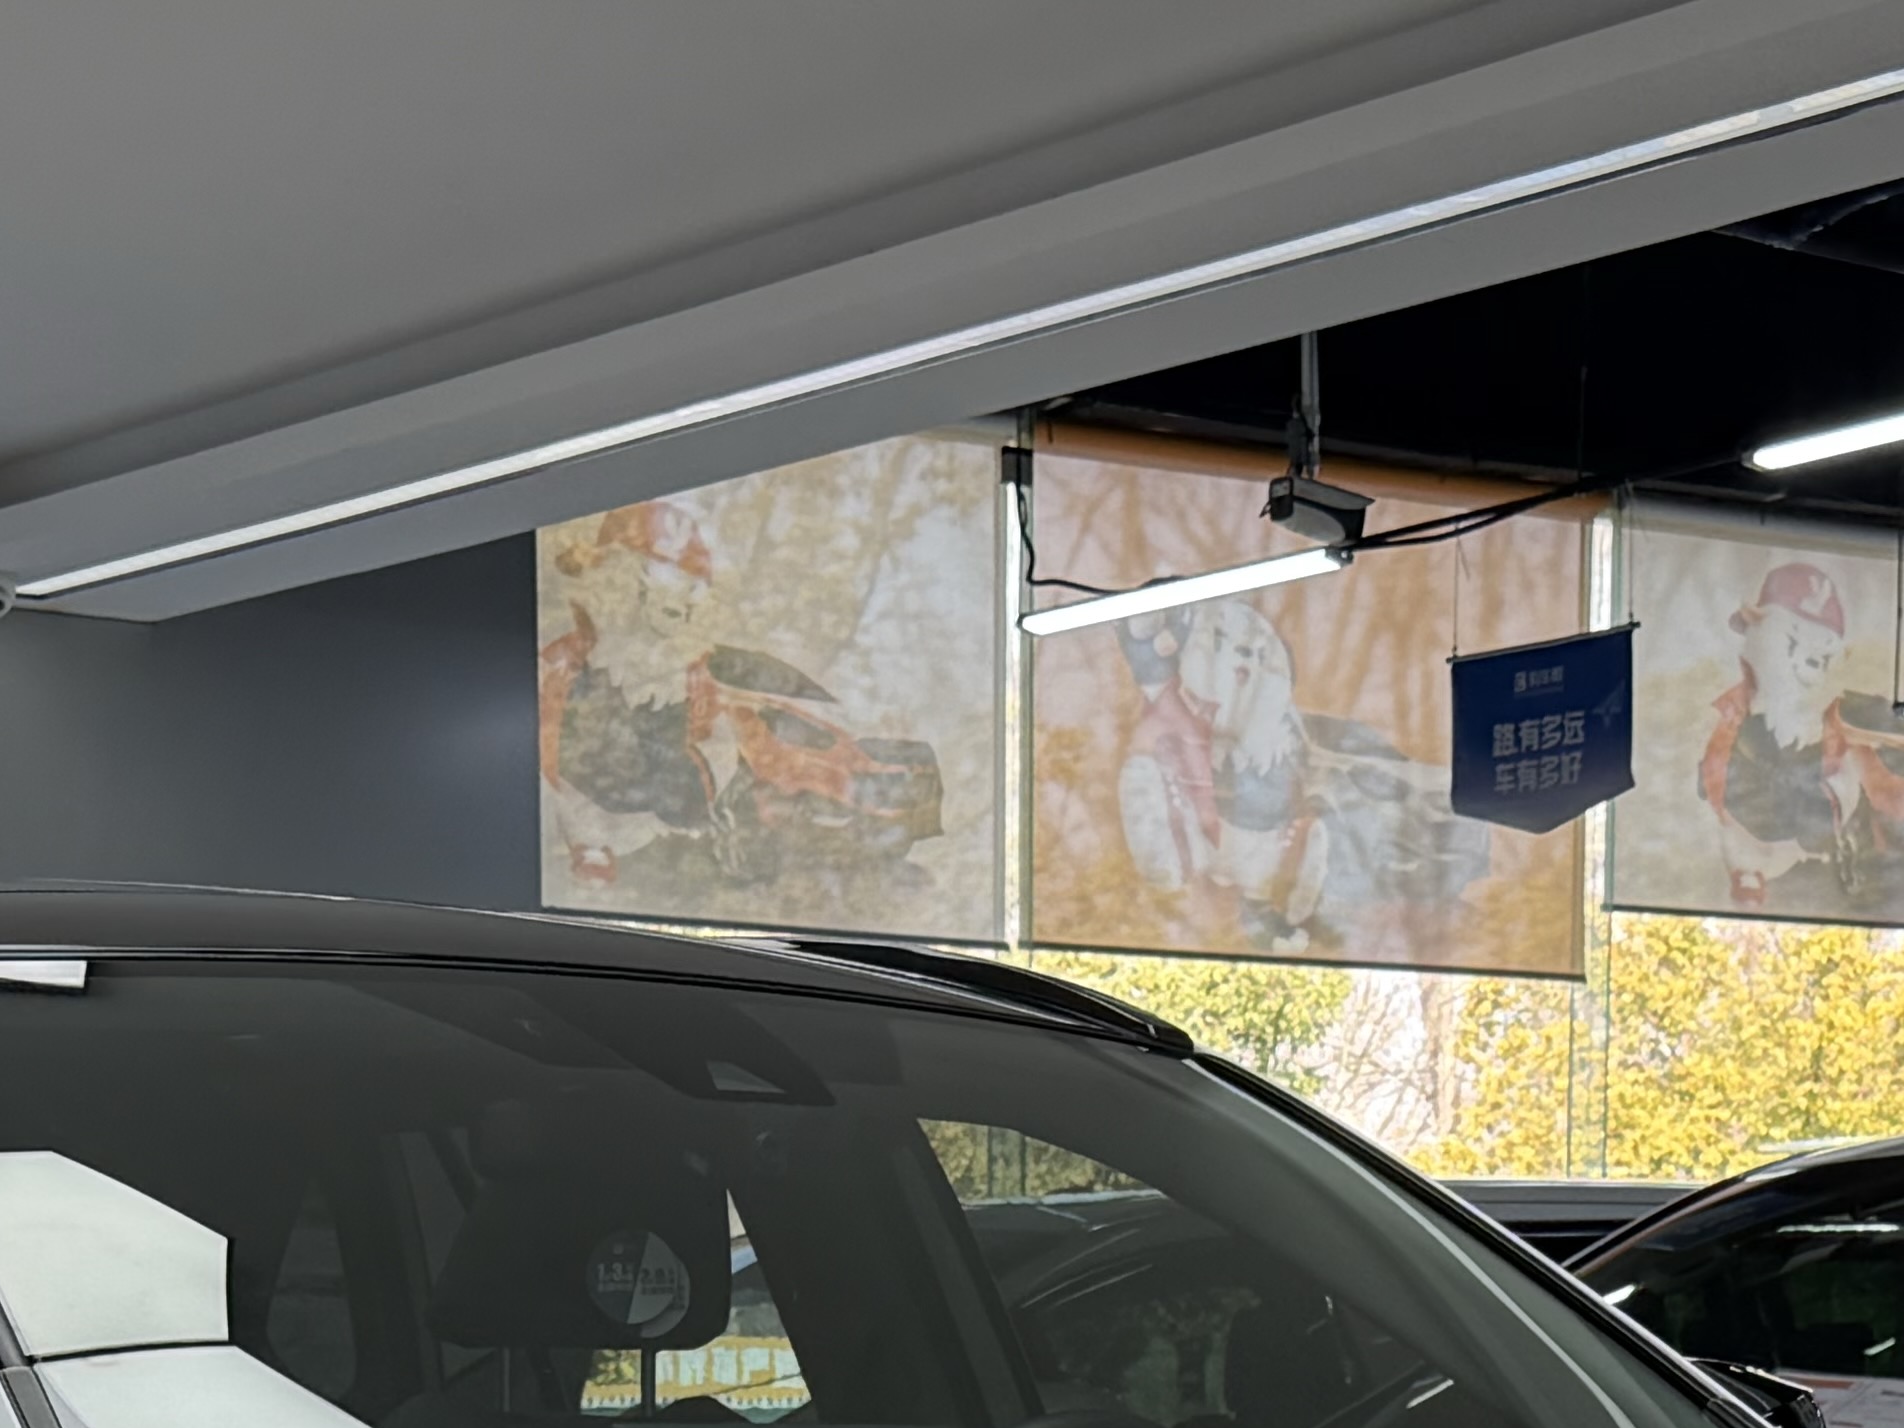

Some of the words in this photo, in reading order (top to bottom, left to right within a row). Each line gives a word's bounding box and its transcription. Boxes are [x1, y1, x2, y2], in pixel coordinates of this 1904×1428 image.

[1492, 709, 1585, 758] 路有多远
[1494, 750, 1583, 795] 车有多好
